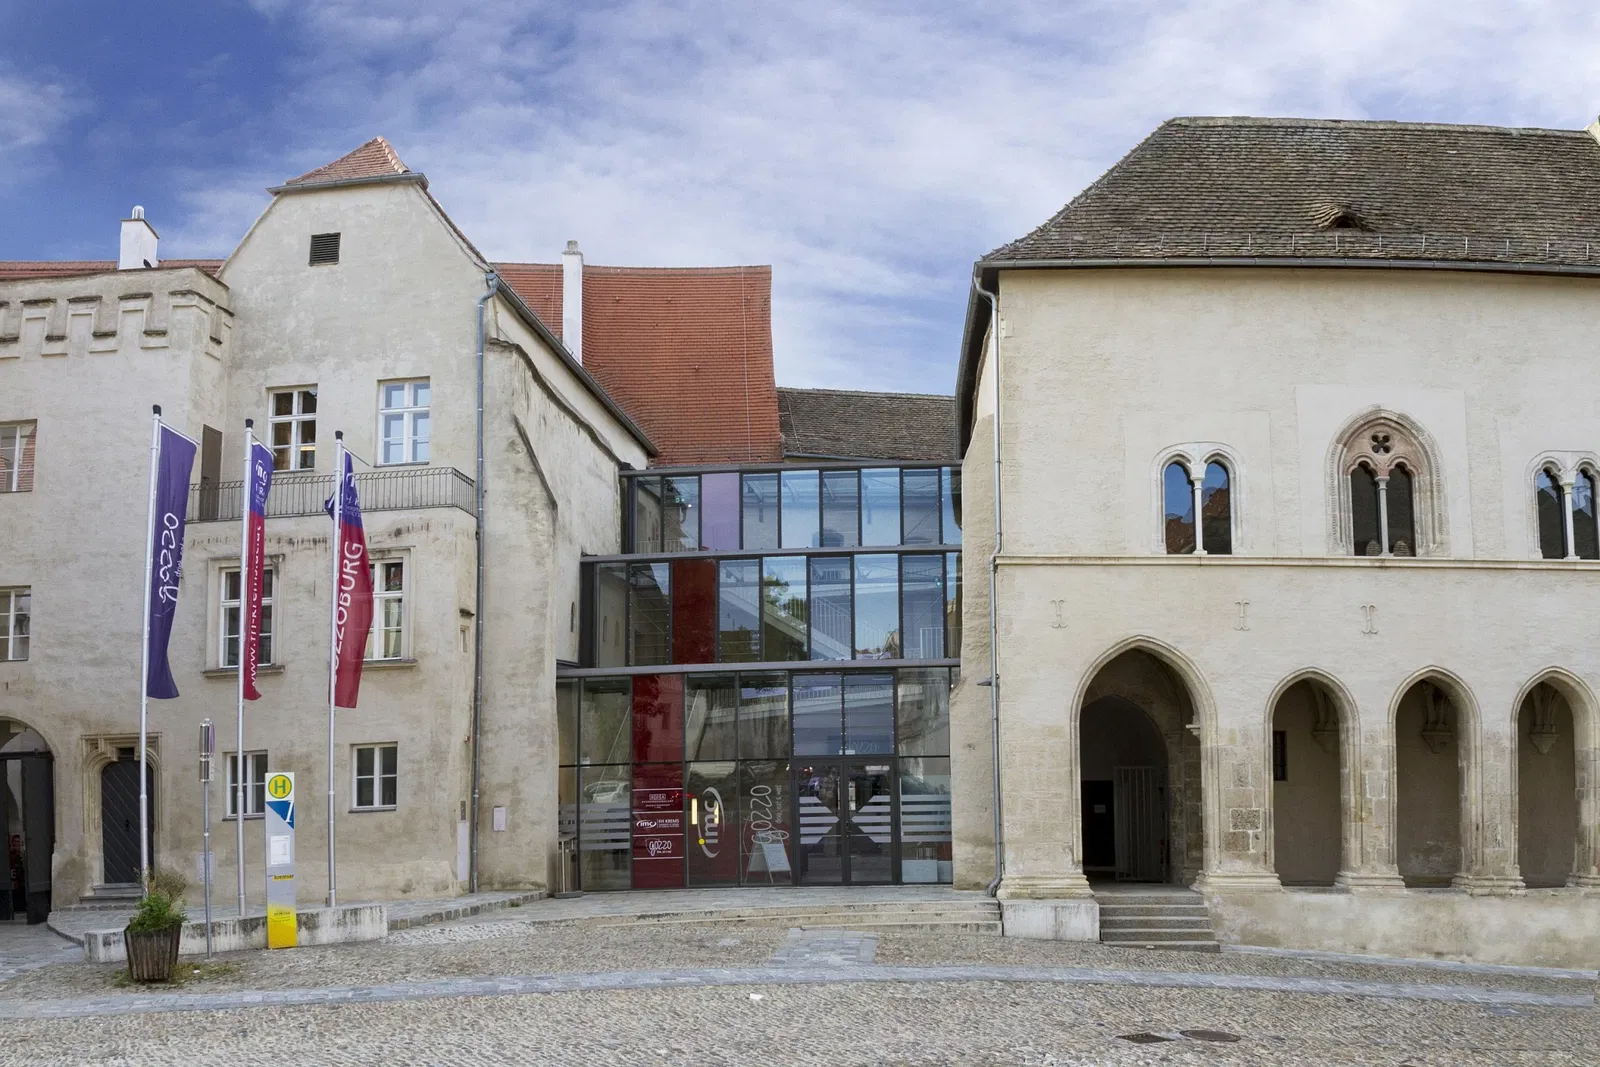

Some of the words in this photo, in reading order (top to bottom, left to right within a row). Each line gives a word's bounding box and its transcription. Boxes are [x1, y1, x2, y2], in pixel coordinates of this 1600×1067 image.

[334, 541, 363, 685] ZZOBURG
[700, 799, 719, 845] imc
[750, 785, 790, 844] gozzo
[648, 840, 672, 856] gozzo
